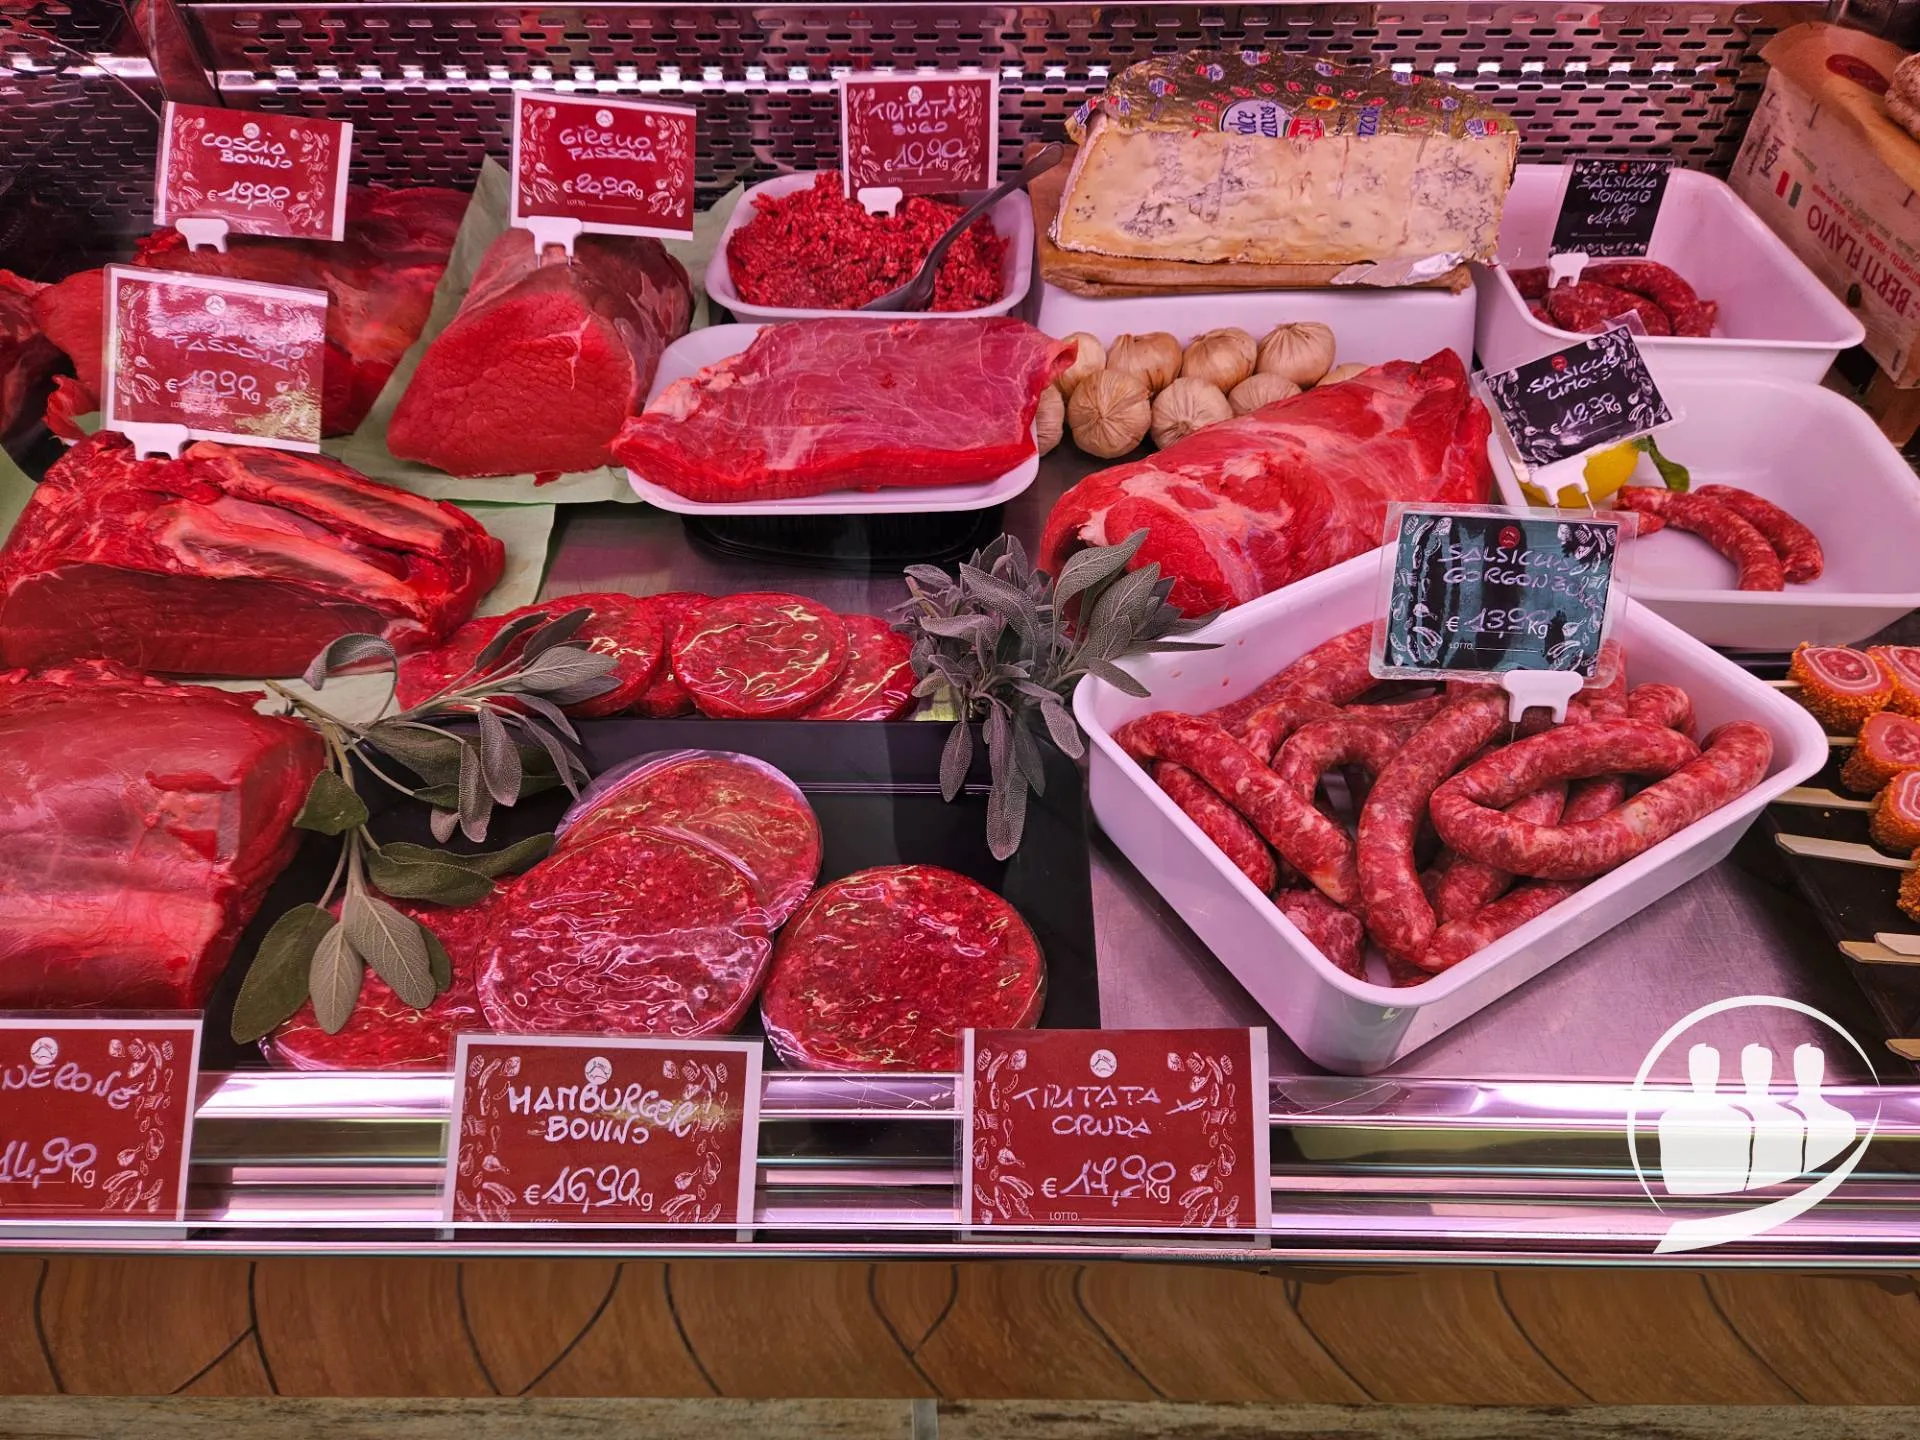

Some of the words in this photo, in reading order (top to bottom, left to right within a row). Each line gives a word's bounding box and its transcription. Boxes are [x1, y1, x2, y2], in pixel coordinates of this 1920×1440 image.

[219, 149, 293, 169] BOVINO
[1807, 204, 1864, 272] FLAVIO
[1862, 254, 1912, 317] BERTI
[508, 1083, 696, 1138] HAMBURGER
[544, 1114, 650, 1145] BOVINO
[1051, 1113, 1153, 1139] CRUDA
[71, 1166, 97, 1190] Kg
[1145, 1179, 1171, 1205] Kg
